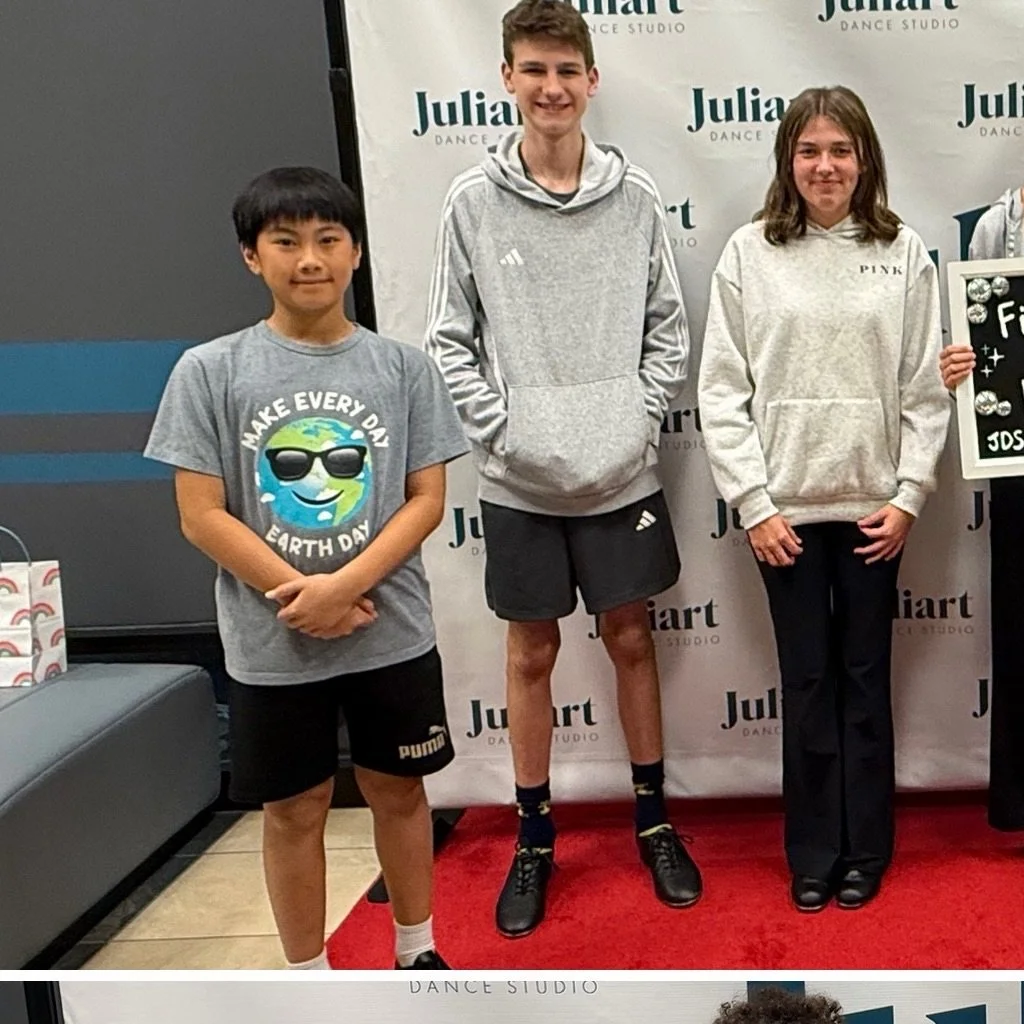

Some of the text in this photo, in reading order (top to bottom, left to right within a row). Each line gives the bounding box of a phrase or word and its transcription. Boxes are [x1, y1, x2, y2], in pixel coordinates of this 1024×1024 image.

[627, 22, 685, 34] STUDIO
[840, 18, 959, 31] DANCE STUDIO
[687, 86, 785, 133] Julia
[435, 133, 488, 145] DANCE
[710, 130, 762, 142] DANCE
[859, 264, 904, 276] PINK
[240, 390, 390, 451] MAKE EVERY DAY
[987, 429, 1024, 451] JDS
[265, 519, 370, 558] EARTH DAY
[897, 590, 973, 619] iart
[399, 733, 446, 759] PUMA
